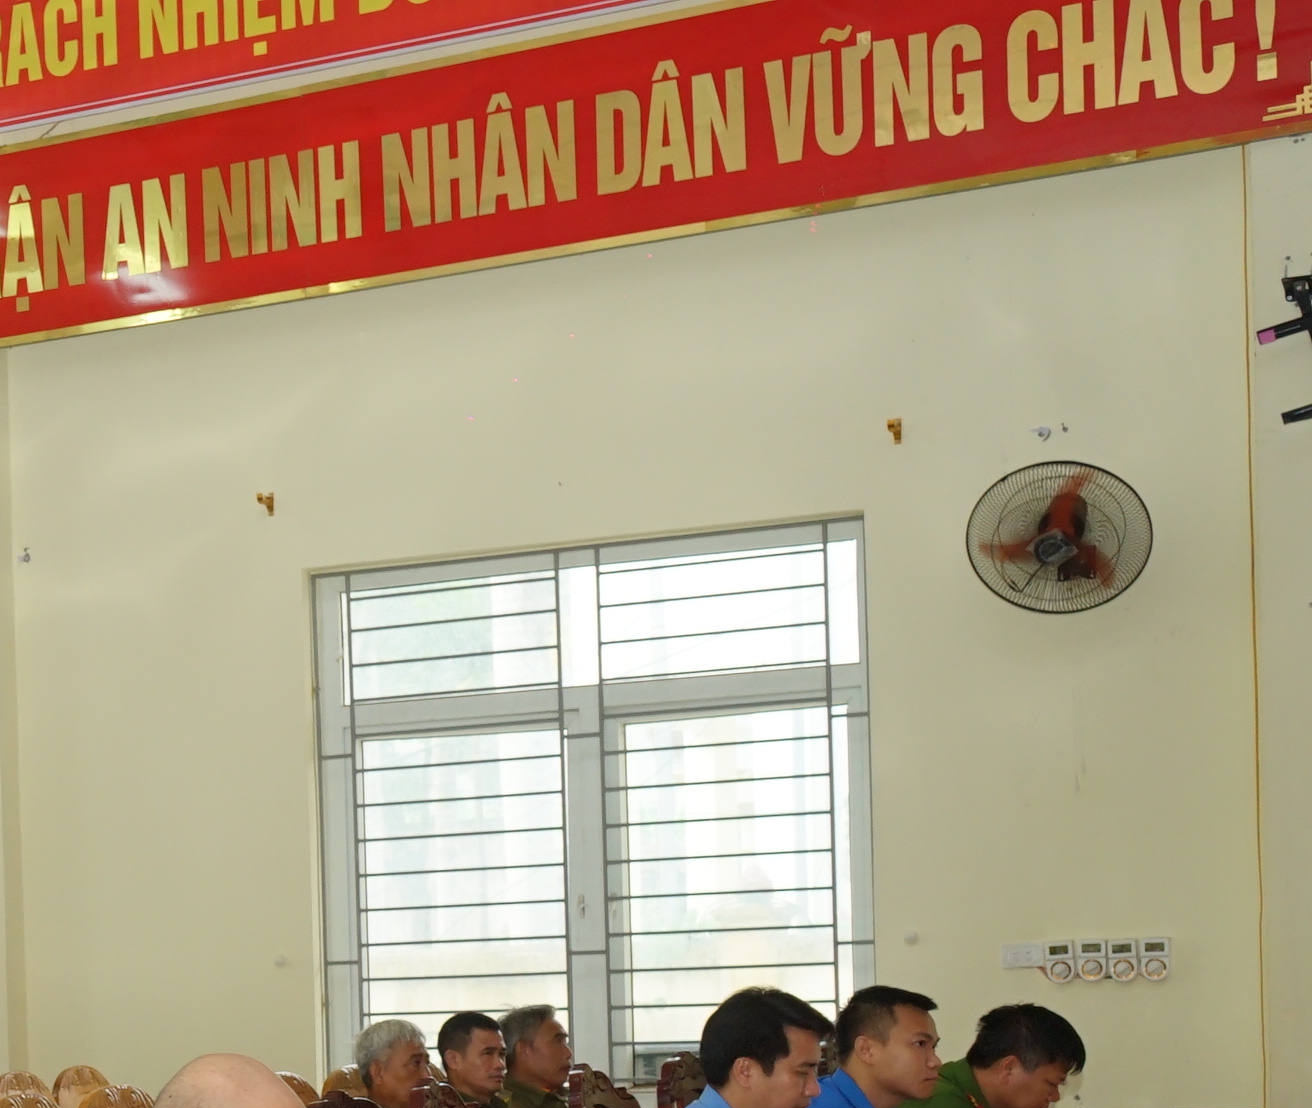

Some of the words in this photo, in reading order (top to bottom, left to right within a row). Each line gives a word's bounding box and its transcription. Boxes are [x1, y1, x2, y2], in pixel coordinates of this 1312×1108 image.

[100, 173, 189, 281] AN
[202, 139, 364, 262] NINH
[381, 92, 578, 233] NHÂN
[595, 58, 747, 196] DÂN
[763, 24, 984, 164] VỮNG
